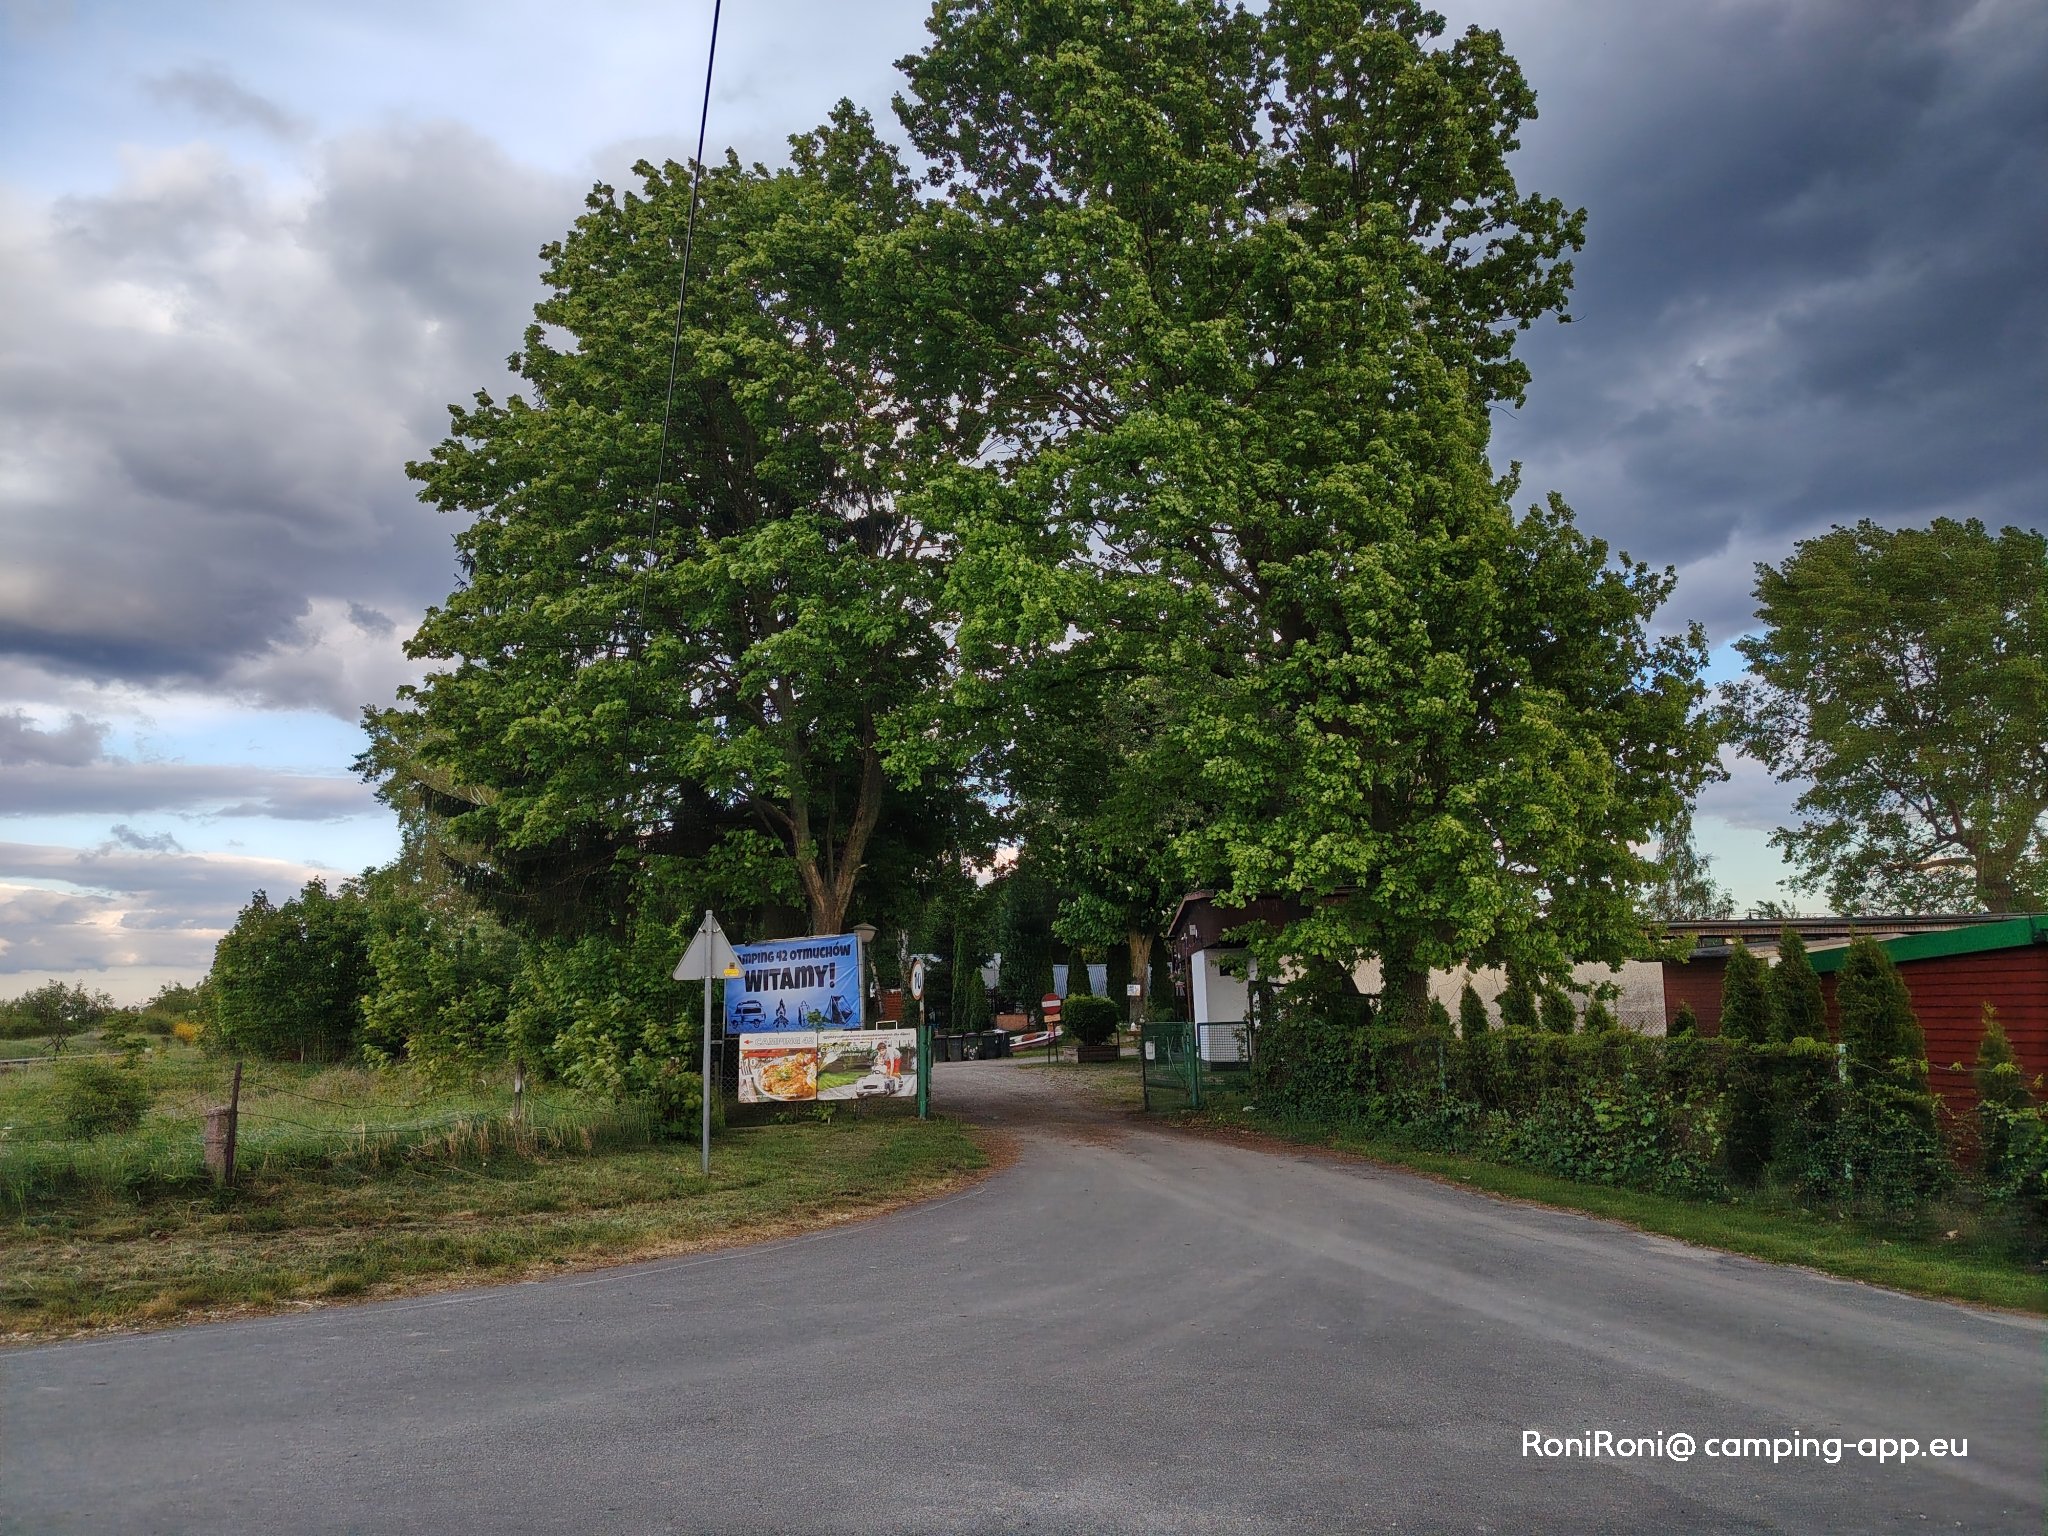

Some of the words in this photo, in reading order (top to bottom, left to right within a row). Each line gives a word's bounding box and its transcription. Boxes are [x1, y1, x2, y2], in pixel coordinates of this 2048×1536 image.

[776, 949, 787, 962] 42
[790, 943, 850, 961] OTMUCHÓW
[745, 963, 835, 992] WITAMY!
[914, 971, 921, 989] 10
